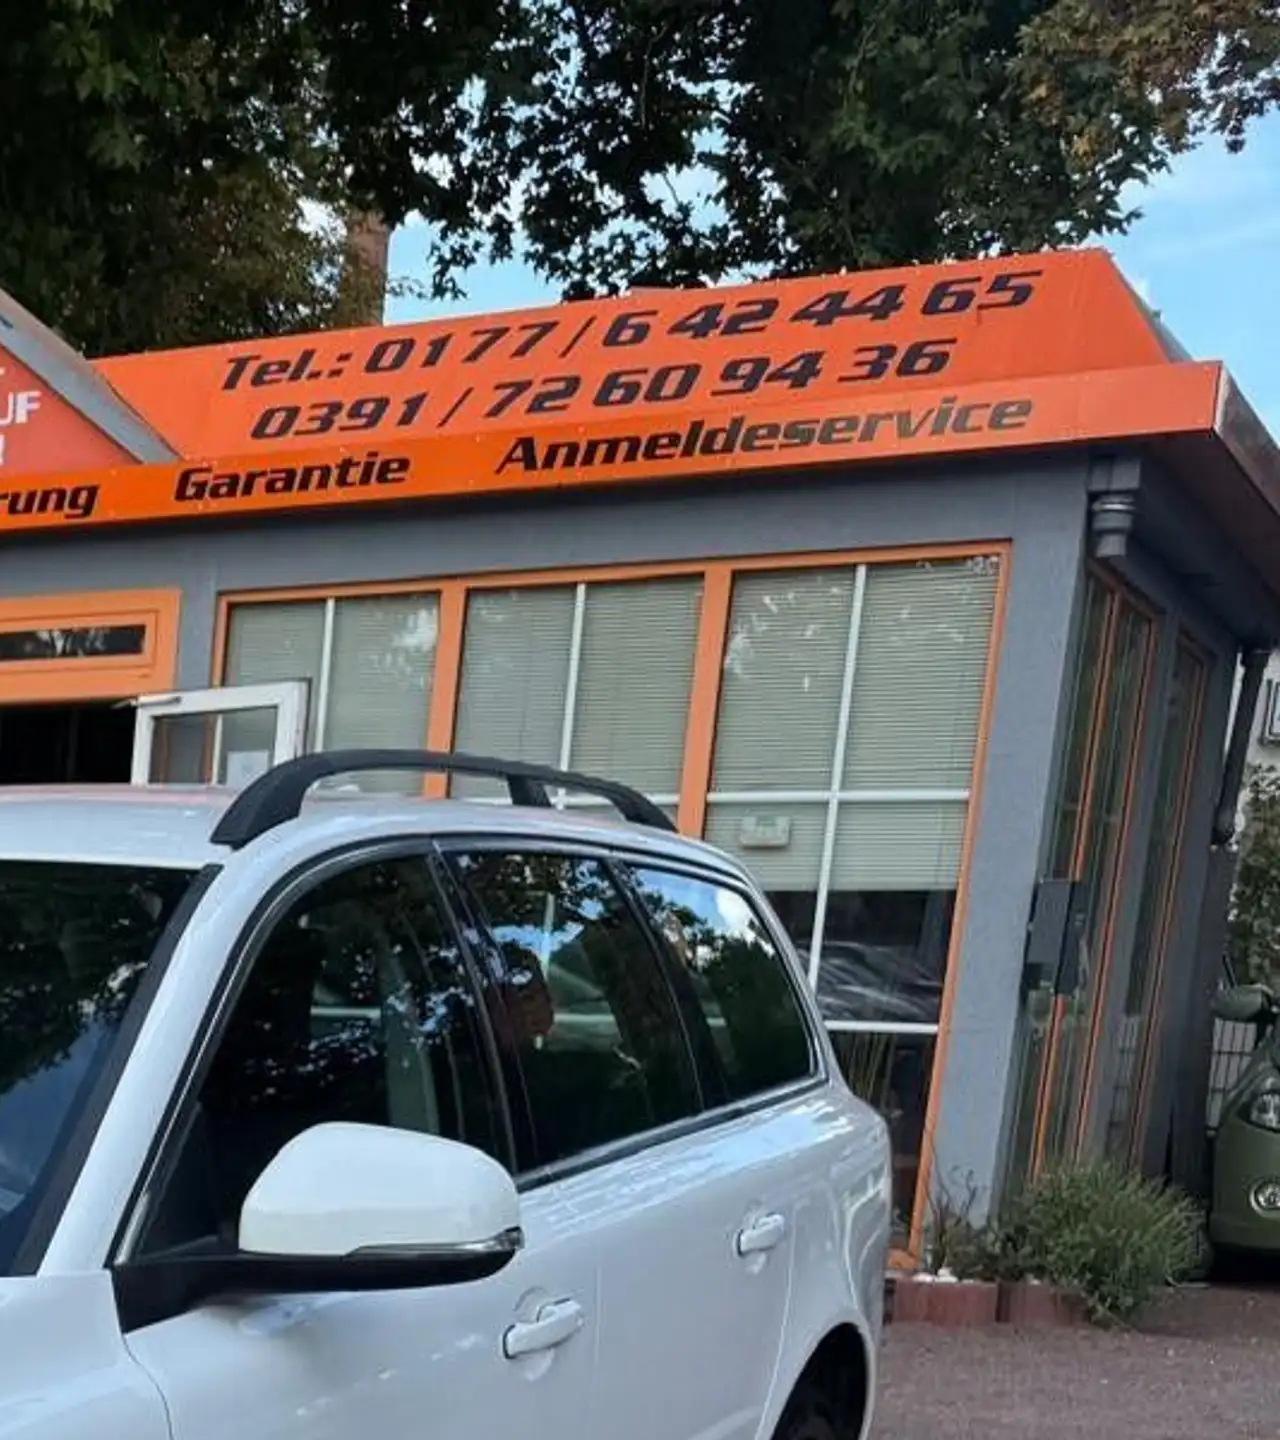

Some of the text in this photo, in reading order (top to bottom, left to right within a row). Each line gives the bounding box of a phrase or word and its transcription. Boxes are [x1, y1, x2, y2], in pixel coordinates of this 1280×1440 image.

[222, 347, 351, 391] Tel.:
[365, 322, 558, 374] 0177
[251, 391, 434, 439] 0391
[496, 396, 1031, 474] Anmeldeservice
[174, 452, 410, 502] Garantie
